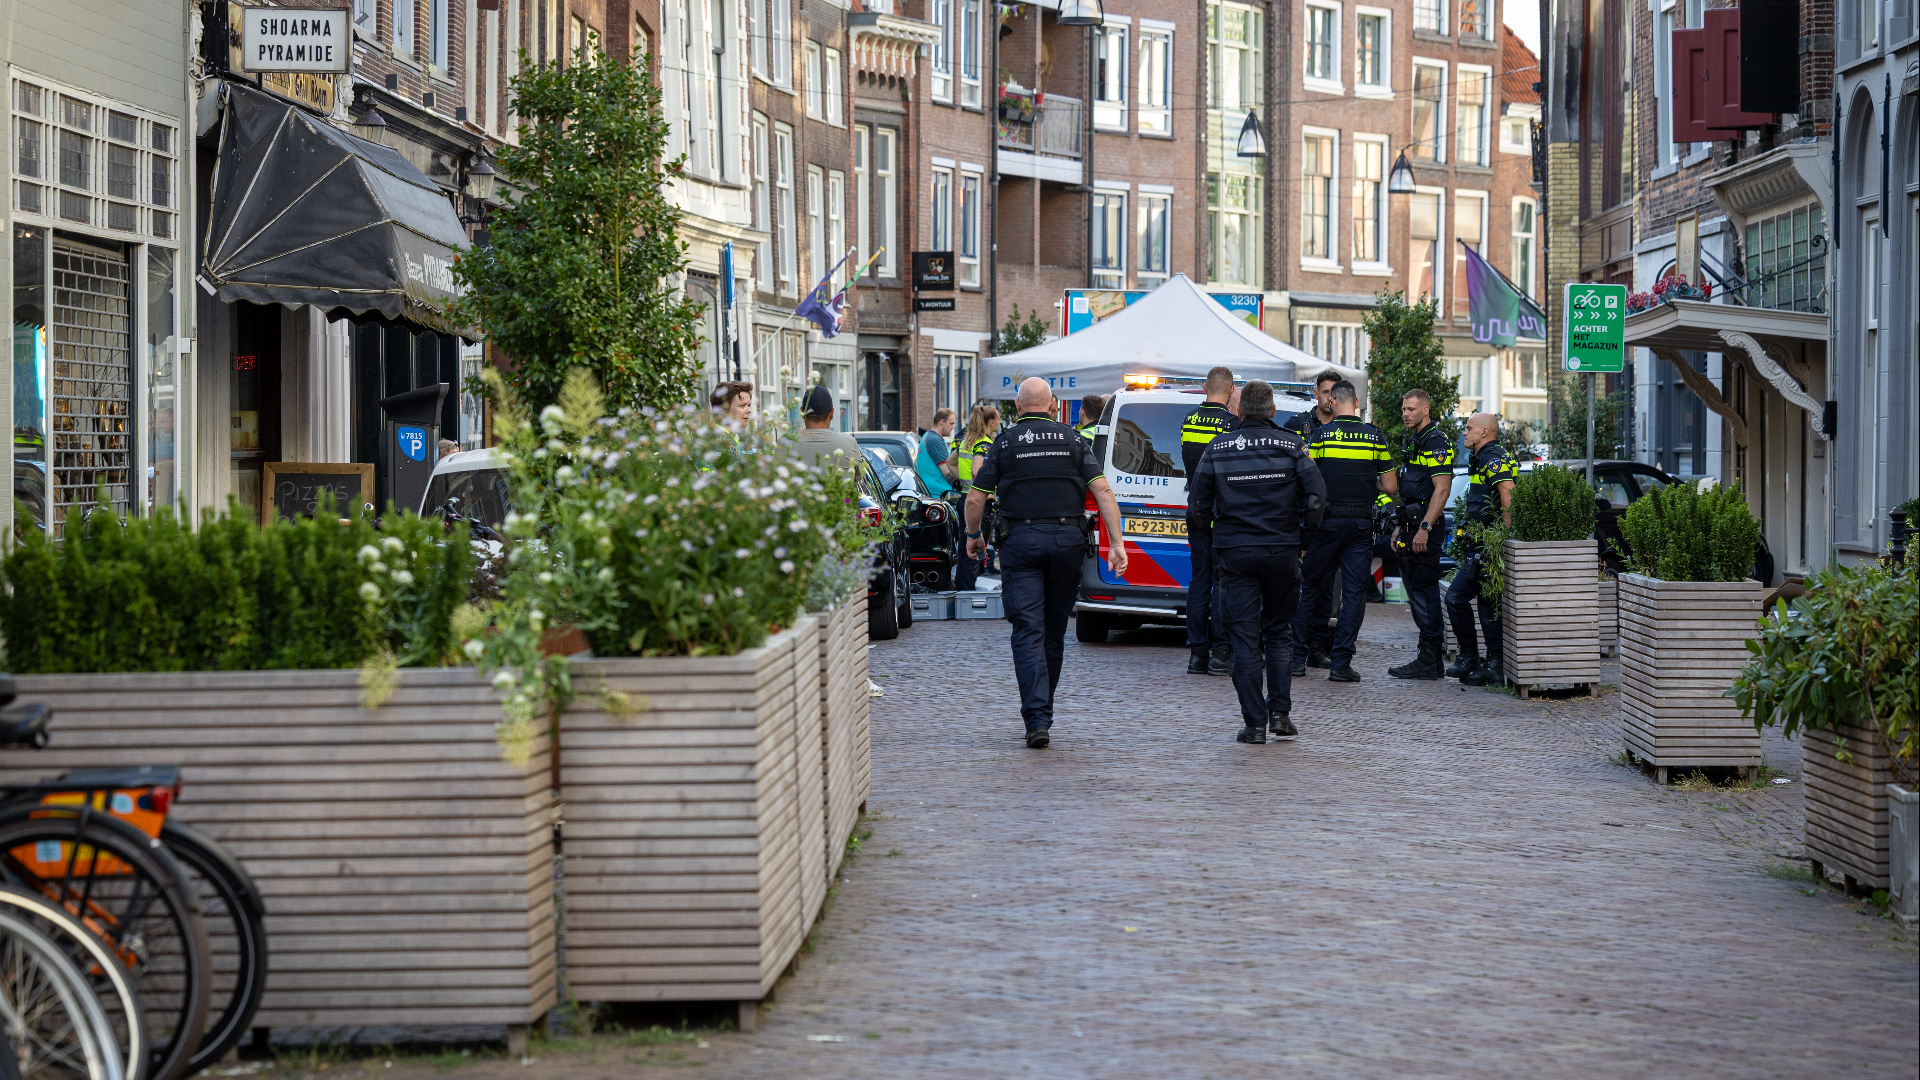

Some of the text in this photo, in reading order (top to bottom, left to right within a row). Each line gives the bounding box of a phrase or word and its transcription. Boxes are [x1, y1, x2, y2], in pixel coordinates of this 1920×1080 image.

[260, 18, 332, 36] SHOARMA
[259, 44, 333, 62] PYRAMIDE
[1230, 294, 1257, 306] 3230
[1573, 324, 1608, 333] ACHTER
[1573, 333, 1590, 341] HET
[1573, 341, 1618, 351] MAGAZIJN
[1002, 376, 1077, 393] PTIE
[1187, 413, 1220, 424] POLITIE
[405, 432, 423, 440] 7815
[1018, 430, 1065, 444] POLITIE
[1329, 429, 1369, 441] POLITIE
[410, 439, 422, 457] P
[1228, 436, 1280, 450] POLITIE
[1116, 475, 1169, 487] POLITIE
[1128, 519, 1188, 535] R-923-NG
